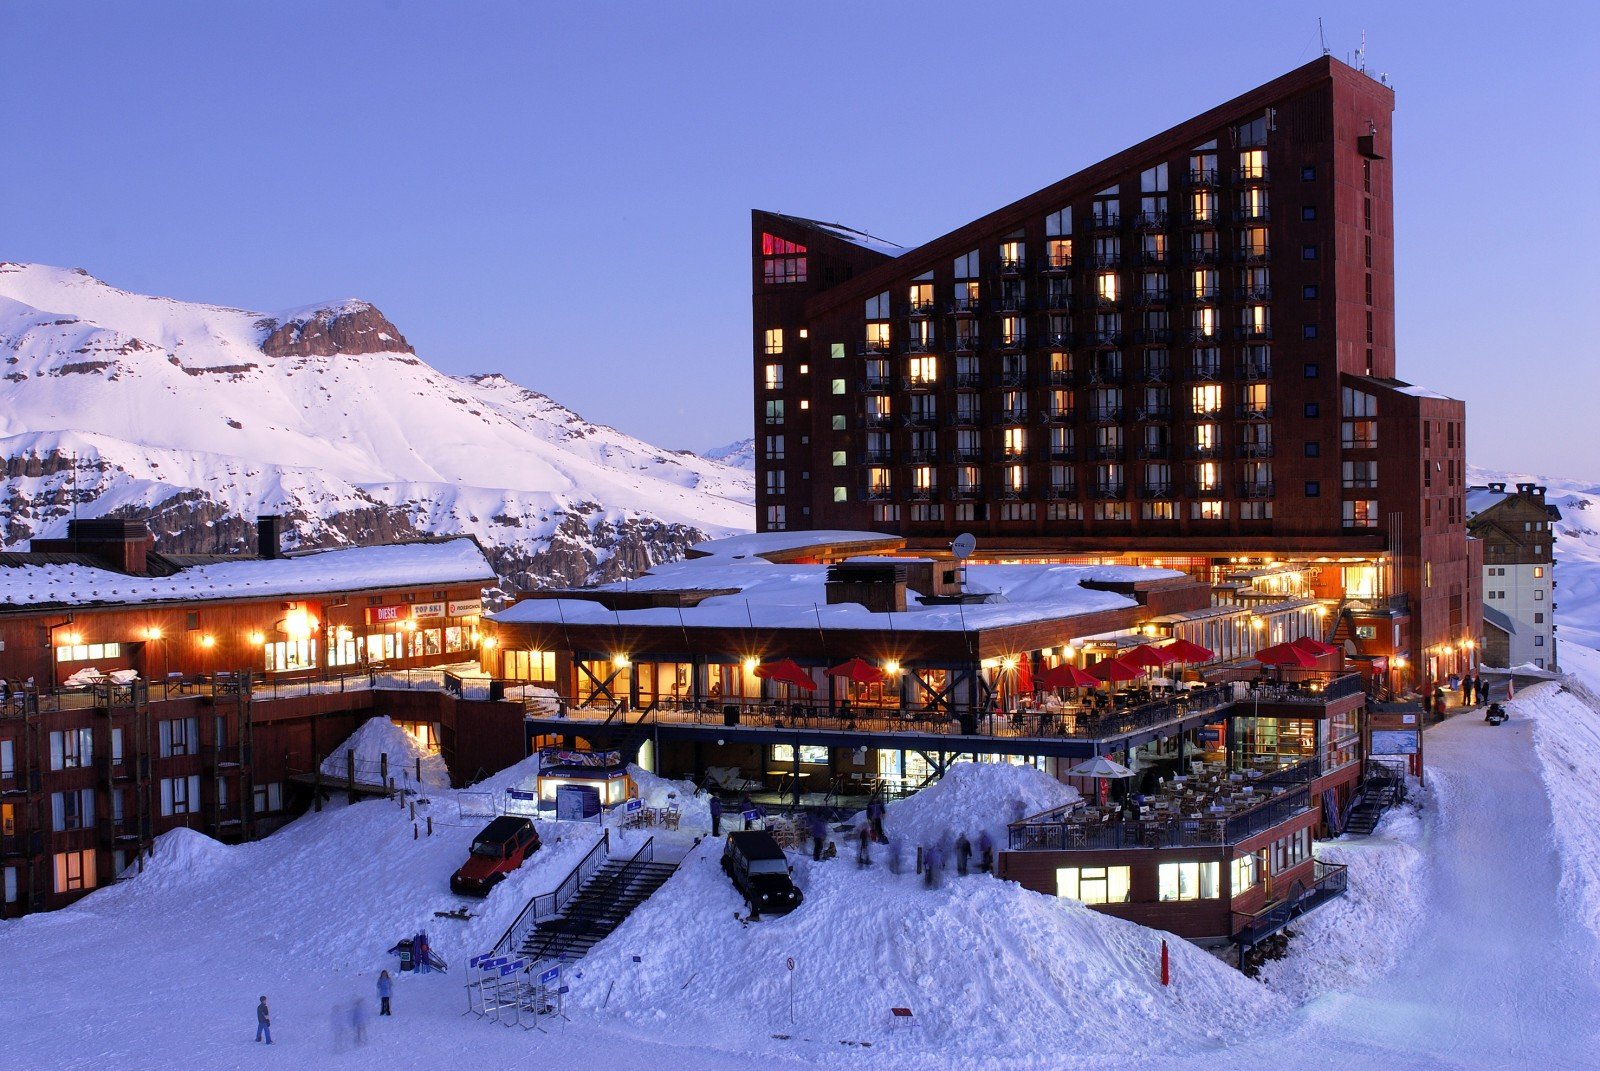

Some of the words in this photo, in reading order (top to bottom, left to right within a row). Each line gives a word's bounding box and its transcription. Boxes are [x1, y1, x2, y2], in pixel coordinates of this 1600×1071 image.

[378, 608, 397, 619] DIESEL
[415, 605, 428, 613] TOP
[429, 604, 441, 612] SKI
